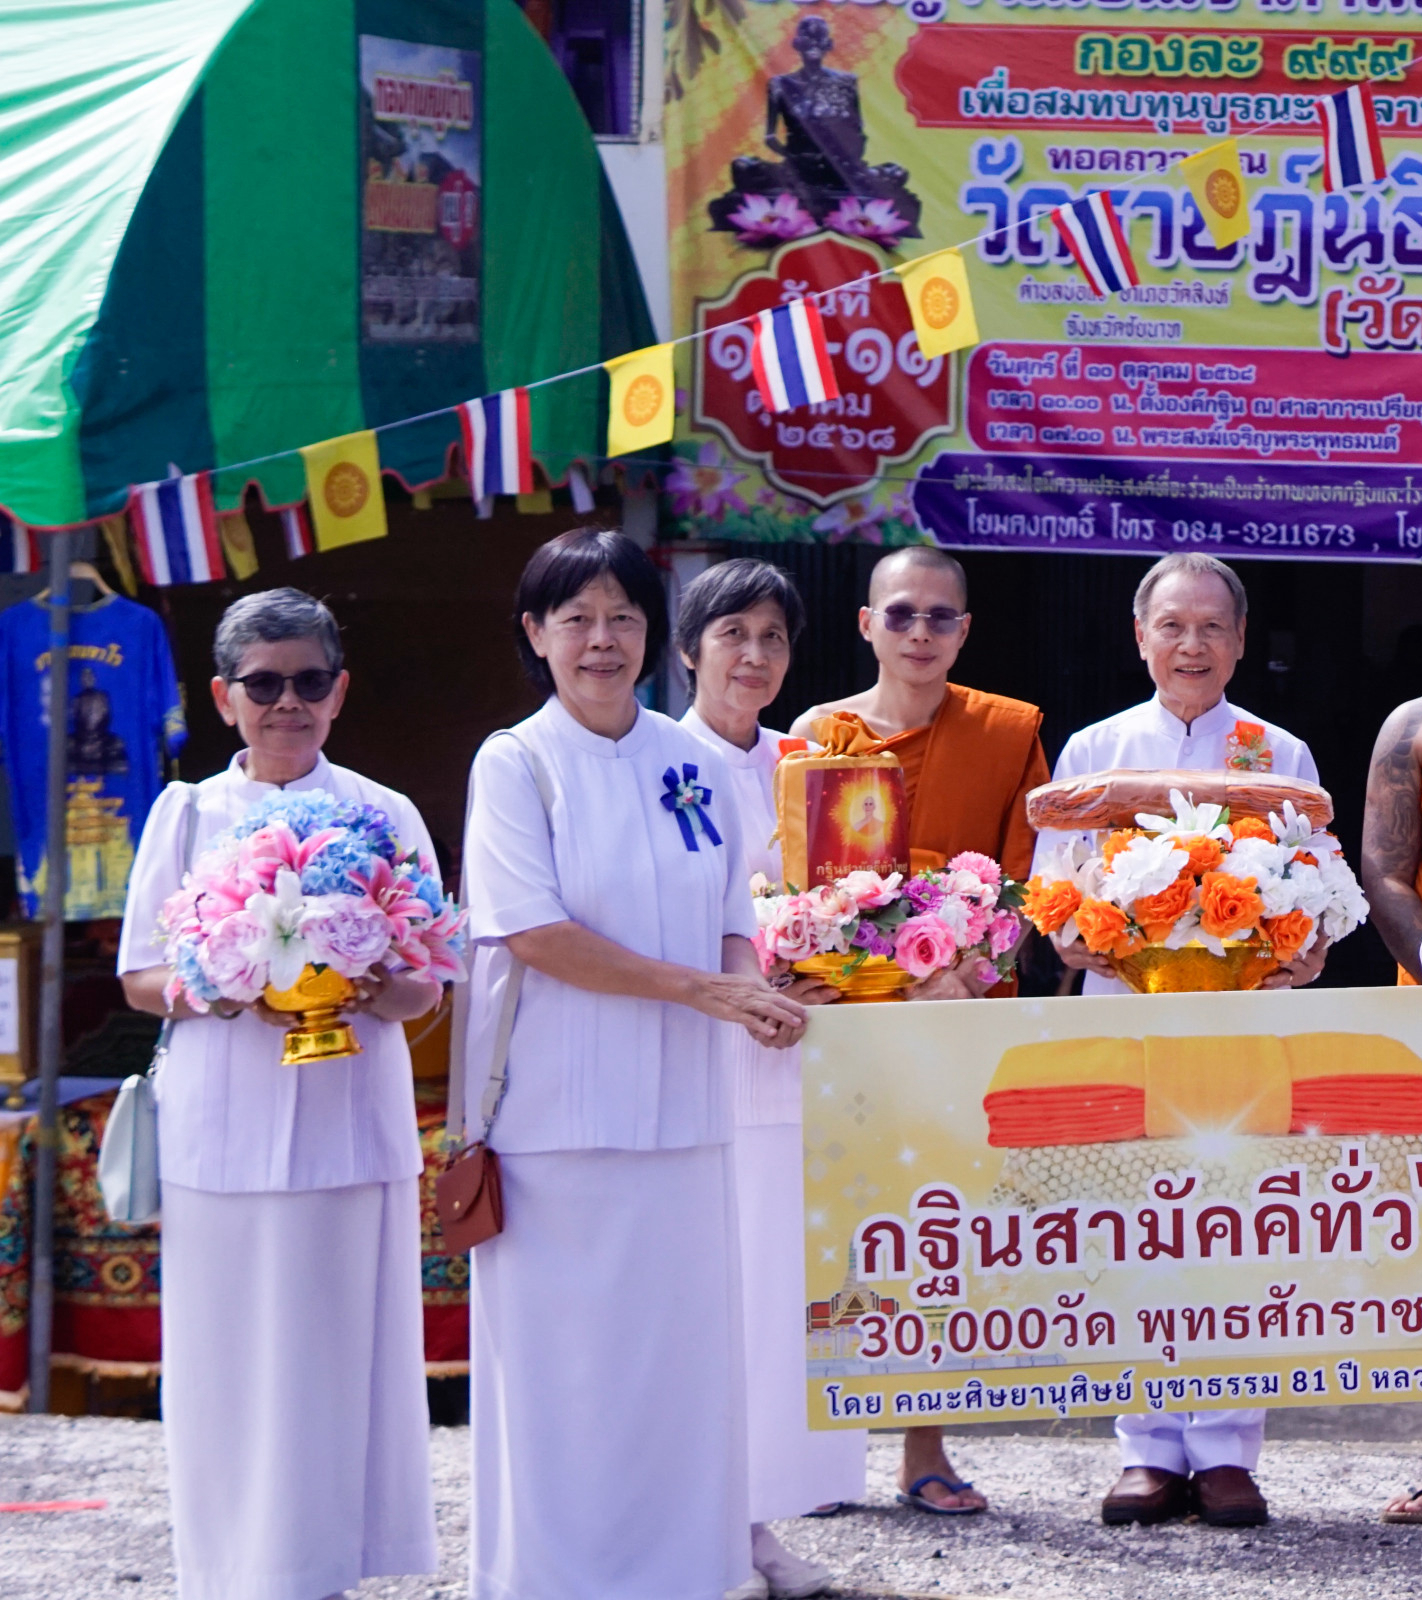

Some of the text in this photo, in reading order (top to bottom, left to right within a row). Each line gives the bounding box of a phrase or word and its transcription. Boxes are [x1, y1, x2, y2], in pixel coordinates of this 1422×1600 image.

[1078, 35, 1258, 75] กองละ
[1286, 40, 1409, 78] ๙๙๙
[1047, 147, 1208, 173] ทอดถวา
[1066, 313, 1182, 340] จังหวัดชัยนาท
[709, 324, 944, 389] ๑-๑๑
[989, 352, 1056, 384] วันศุกร์
[1063, 348, 1081, 377] ที่
[1122, 362, 1190, 388] ตุลาคม
[989, 390, 1034, 409] เวลา
[1113, 394, 1133, 412] น.
[1139, 382, 1245, 421] ตั้งองค์กฐิน
[1253, 401, 1276, 418] ณ
[989, 421, 1034, 441] เวลา
[1114, 426, 1135, 445] น.
[1140, 425, 1399, 458] พระสงฆ์เจริญพระพุทธมนต์
[1110, 502, 1156, 541] โทร
[1172, 518, 1356, 547] 084-3211673
[860, 1293, 1116, 1365] 30,000วัด
[826, 1385, 883, 1417] โดย
[896, 1370, 1134, 1415] คณะศิษยานุศิษย์
[1144, 1372, 1280, 1411] บูชาธรรม
[1292, 1369, 1326, 1394] 81
[1339, 1361, 1359, 1391] ปี
